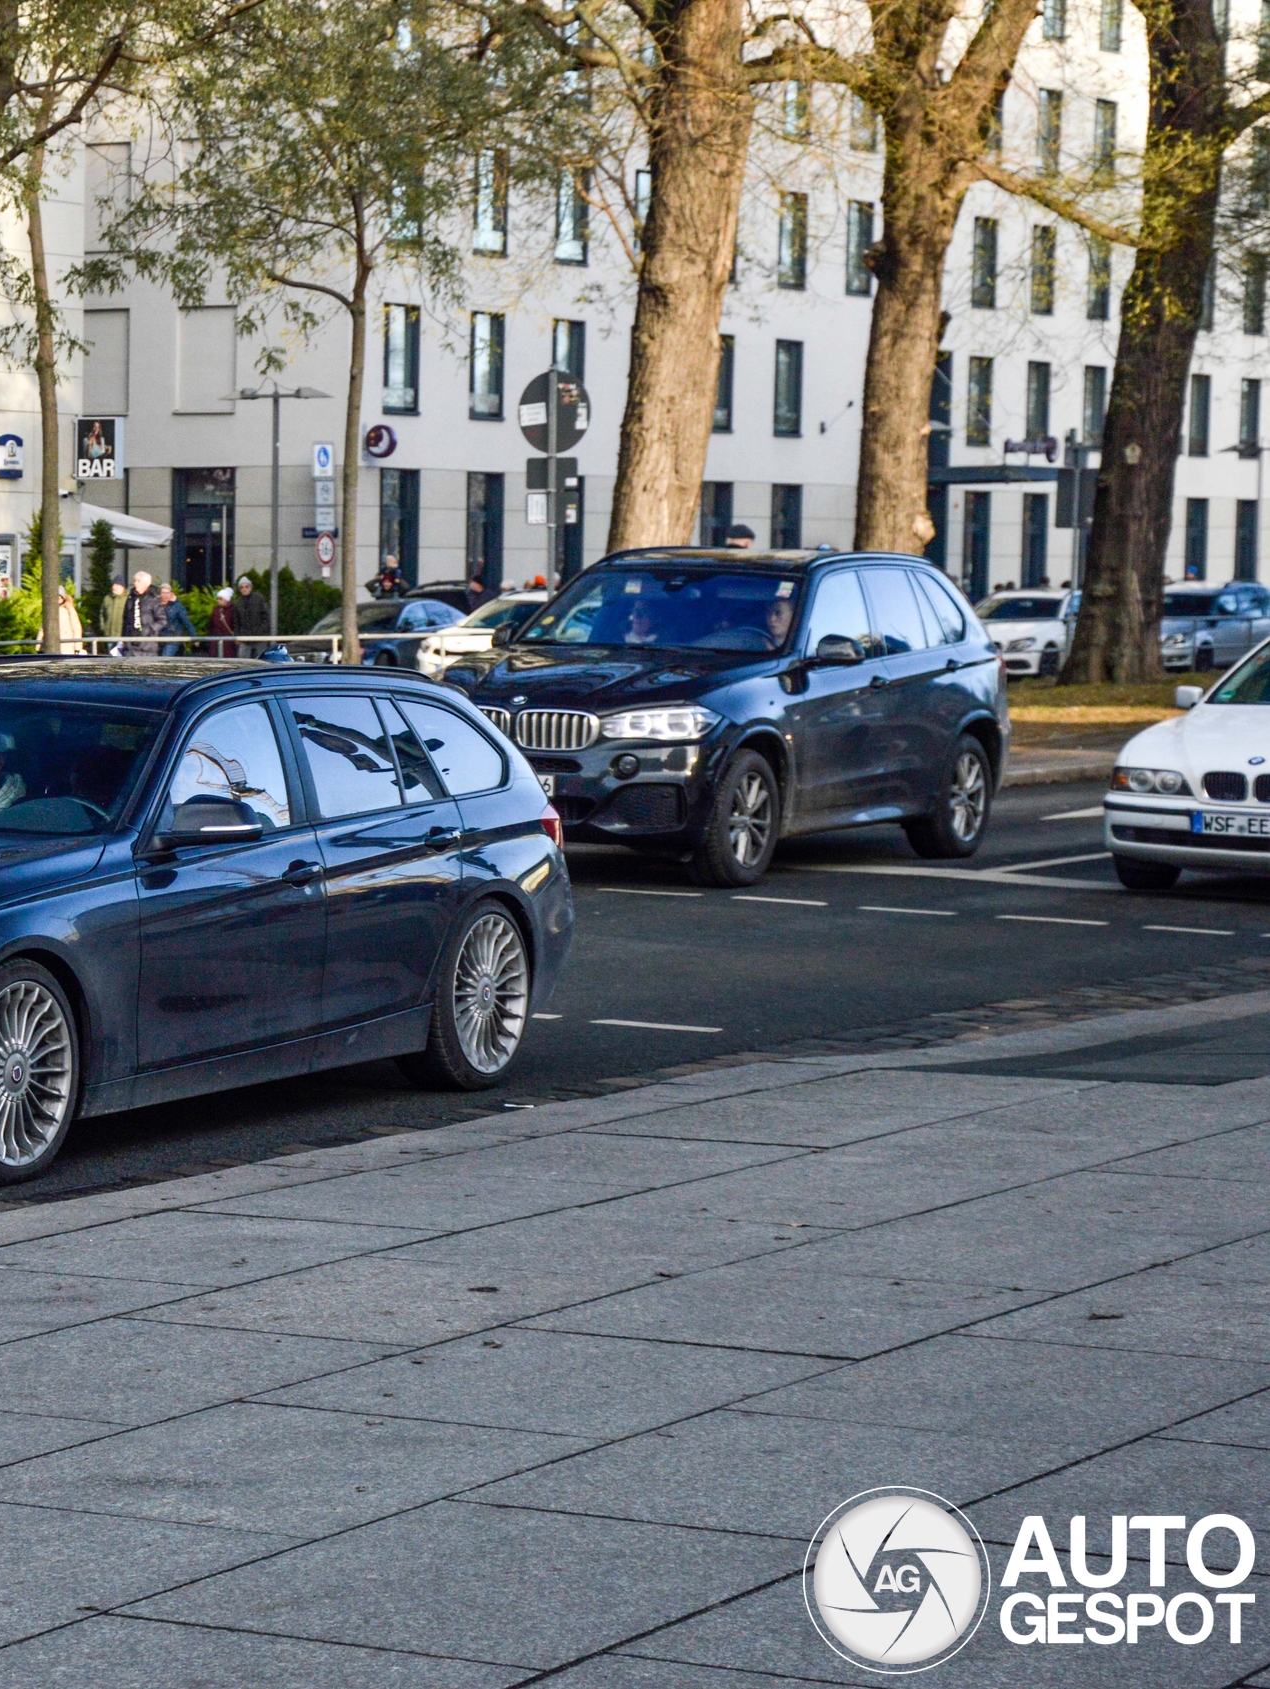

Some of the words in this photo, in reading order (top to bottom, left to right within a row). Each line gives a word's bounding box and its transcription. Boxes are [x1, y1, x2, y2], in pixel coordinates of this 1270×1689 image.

[77, 458, 115, 477] BAR
[542, 777, 551, 792] 6
[1203, 815, 1235, 832] WSF
